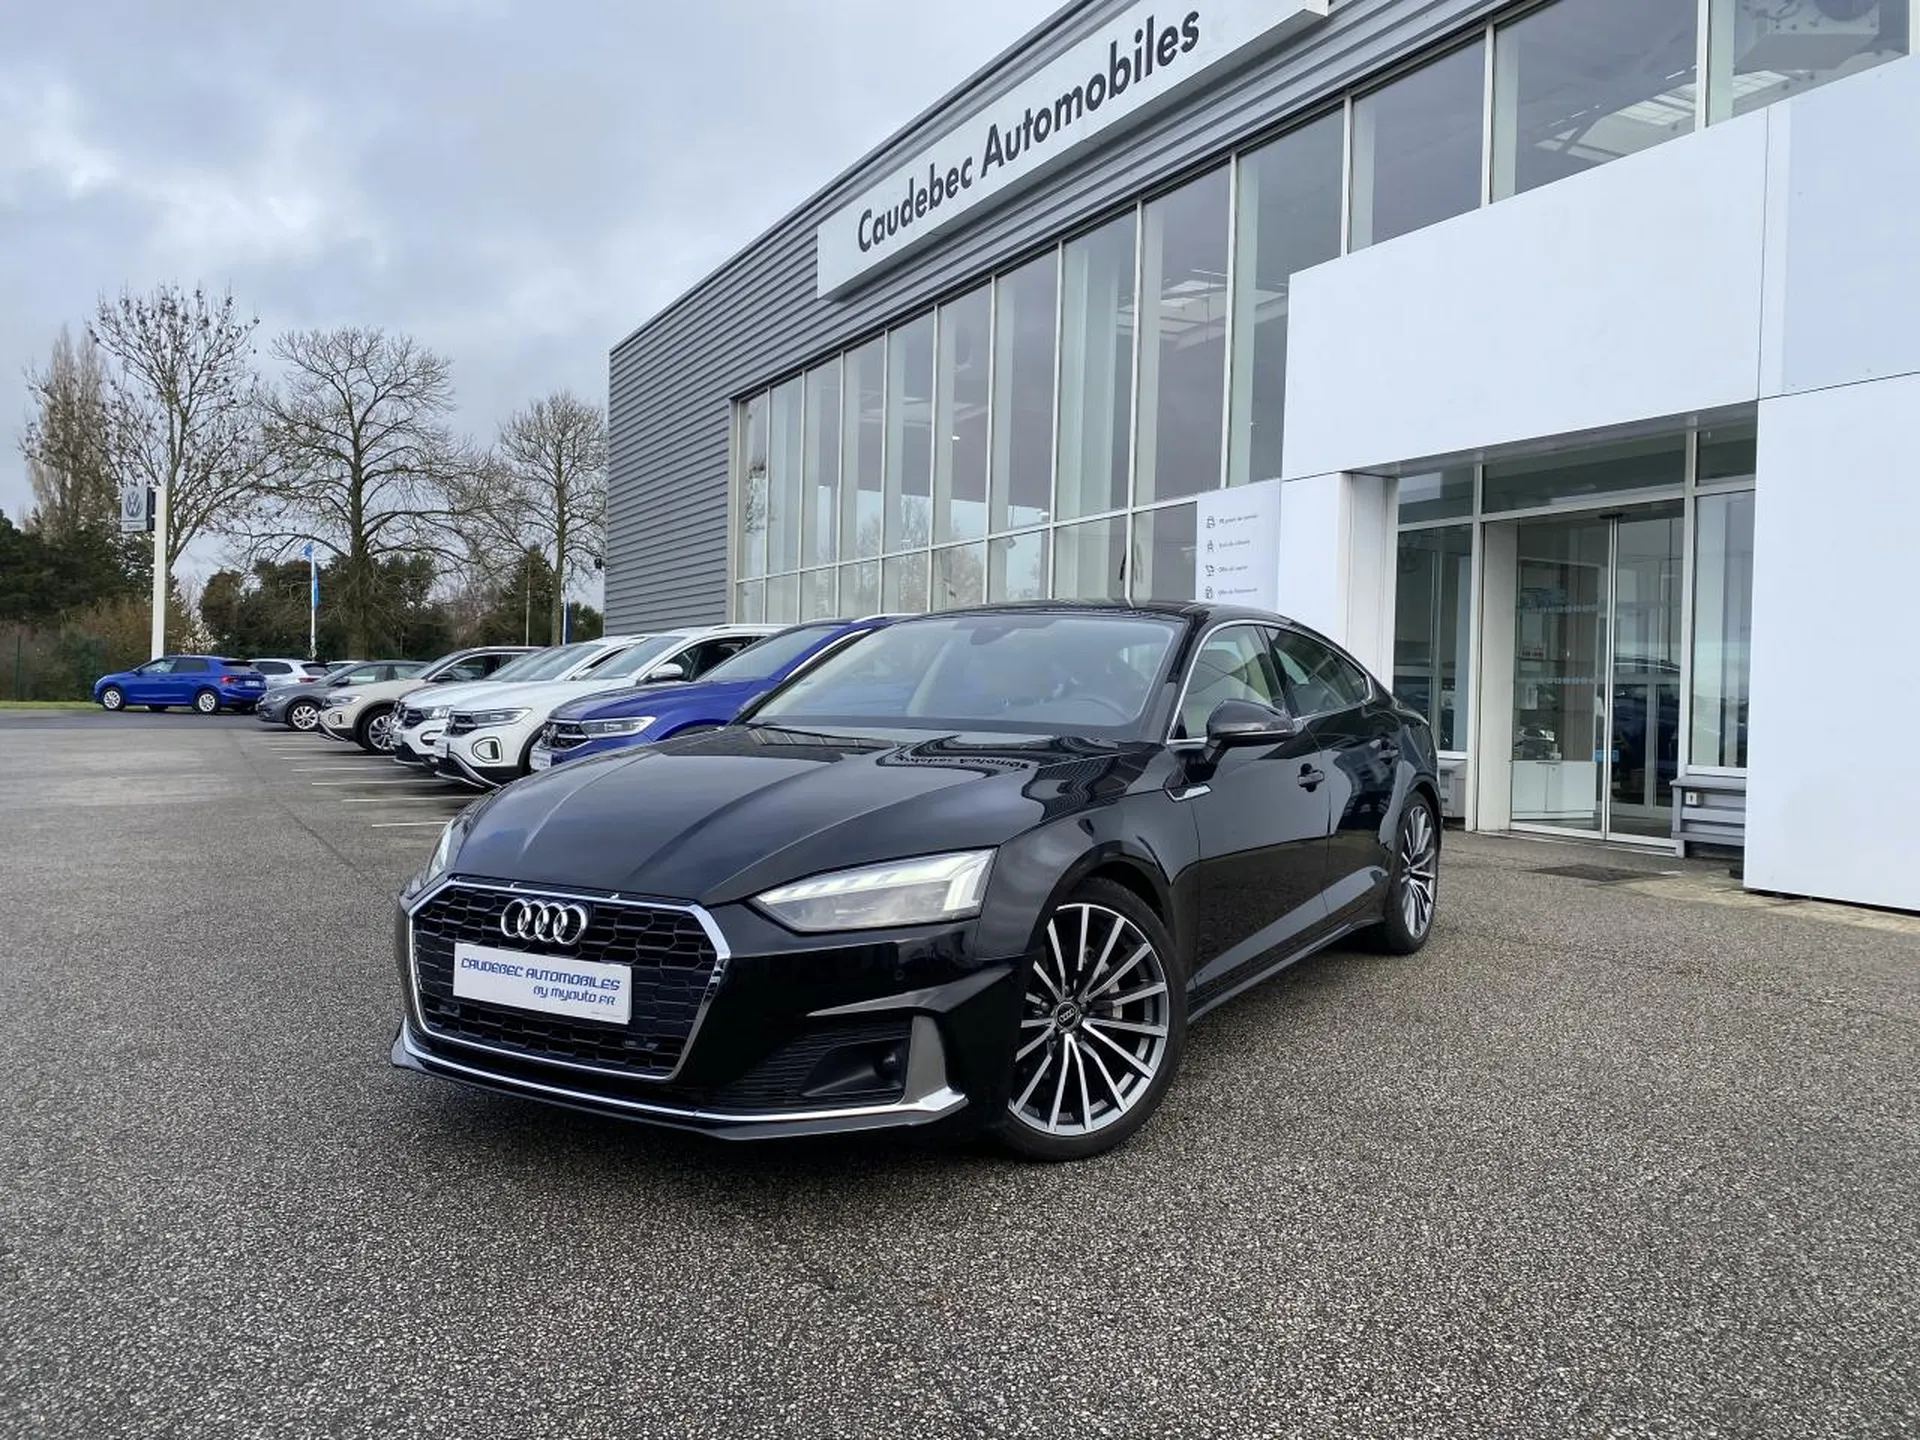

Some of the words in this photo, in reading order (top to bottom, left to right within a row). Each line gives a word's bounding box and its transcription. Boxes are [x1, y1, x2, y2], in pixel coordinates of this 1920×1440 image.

[857, 156, 973, 253] Caudebec
[980, 9, 1200, 179] Automobiles
[461, 957, 523, 977] CAUDEBEC
[526, 968, 621, 991] AUTOMOBILES
